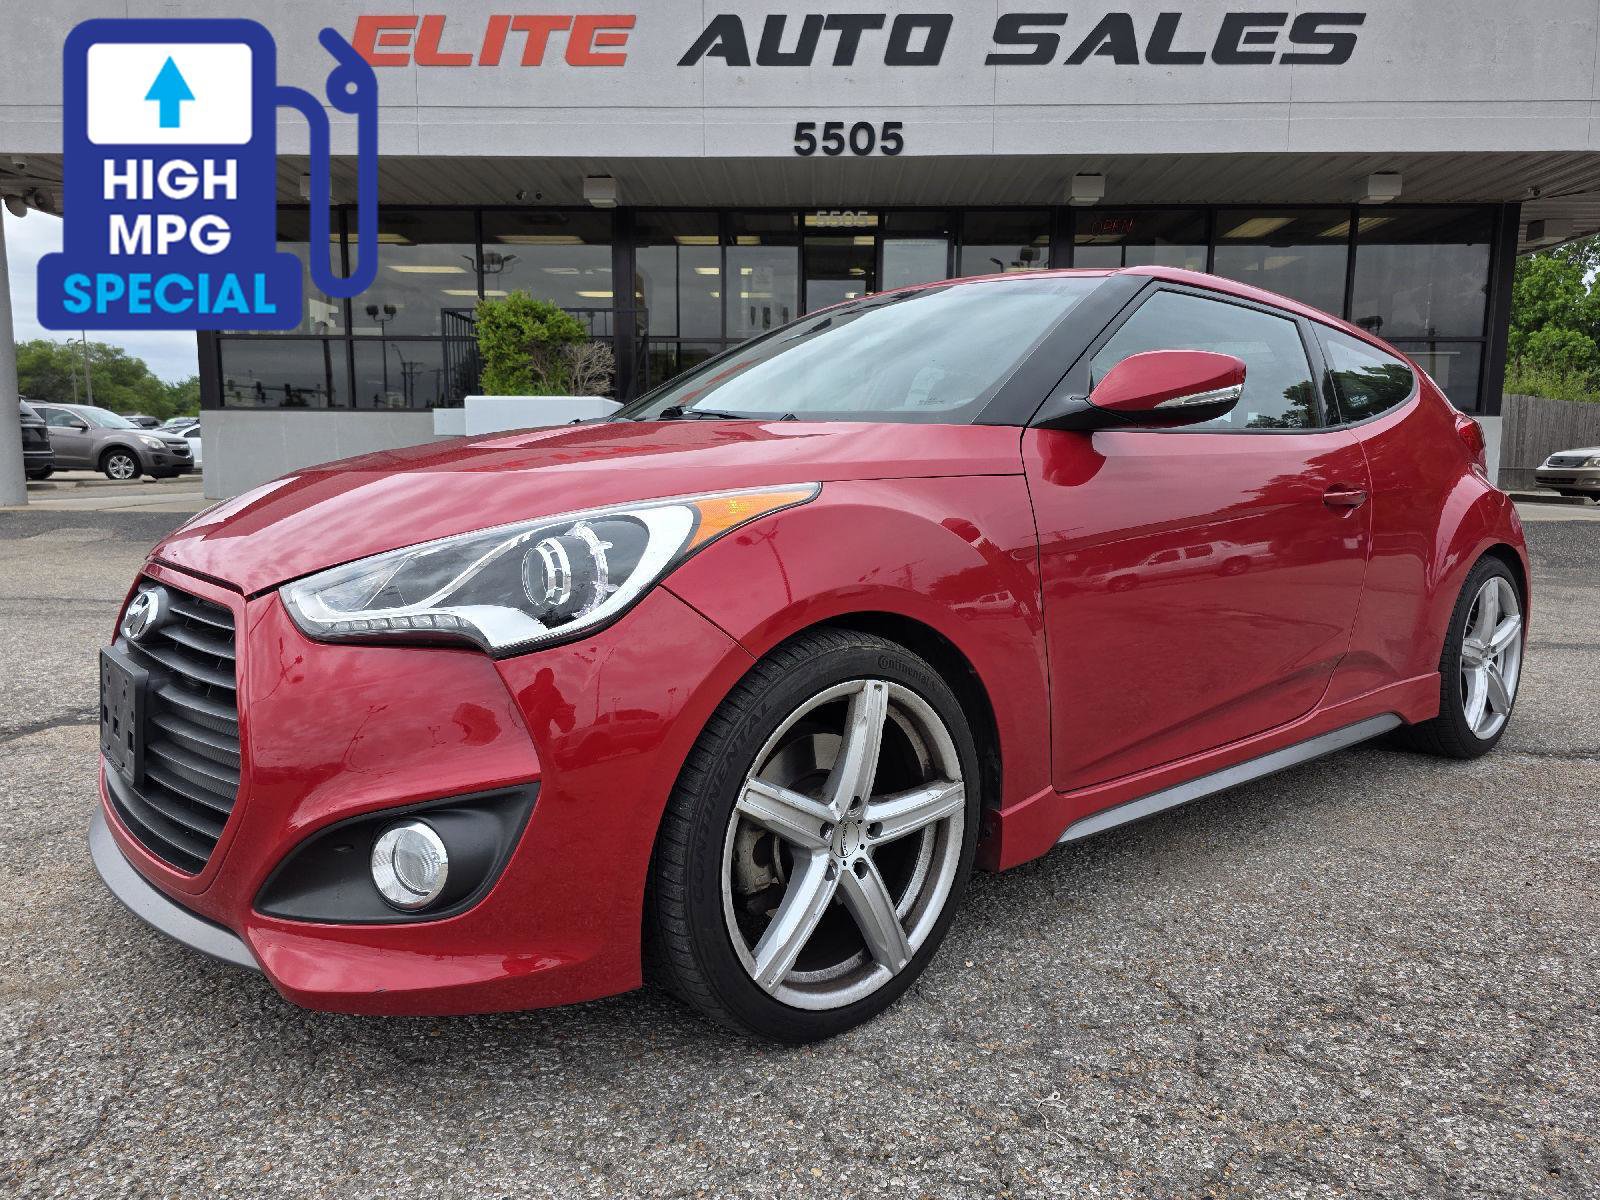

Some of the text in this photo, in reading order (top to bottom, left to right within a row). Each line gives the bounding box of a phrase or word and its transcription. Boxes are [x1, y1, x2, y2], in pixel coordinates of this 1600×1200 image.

[352, 12, 1367, 67] ELITE AUTO SALES
[794, 121, 904, 156] 5505
[816, 210, 868, 227] 5505
